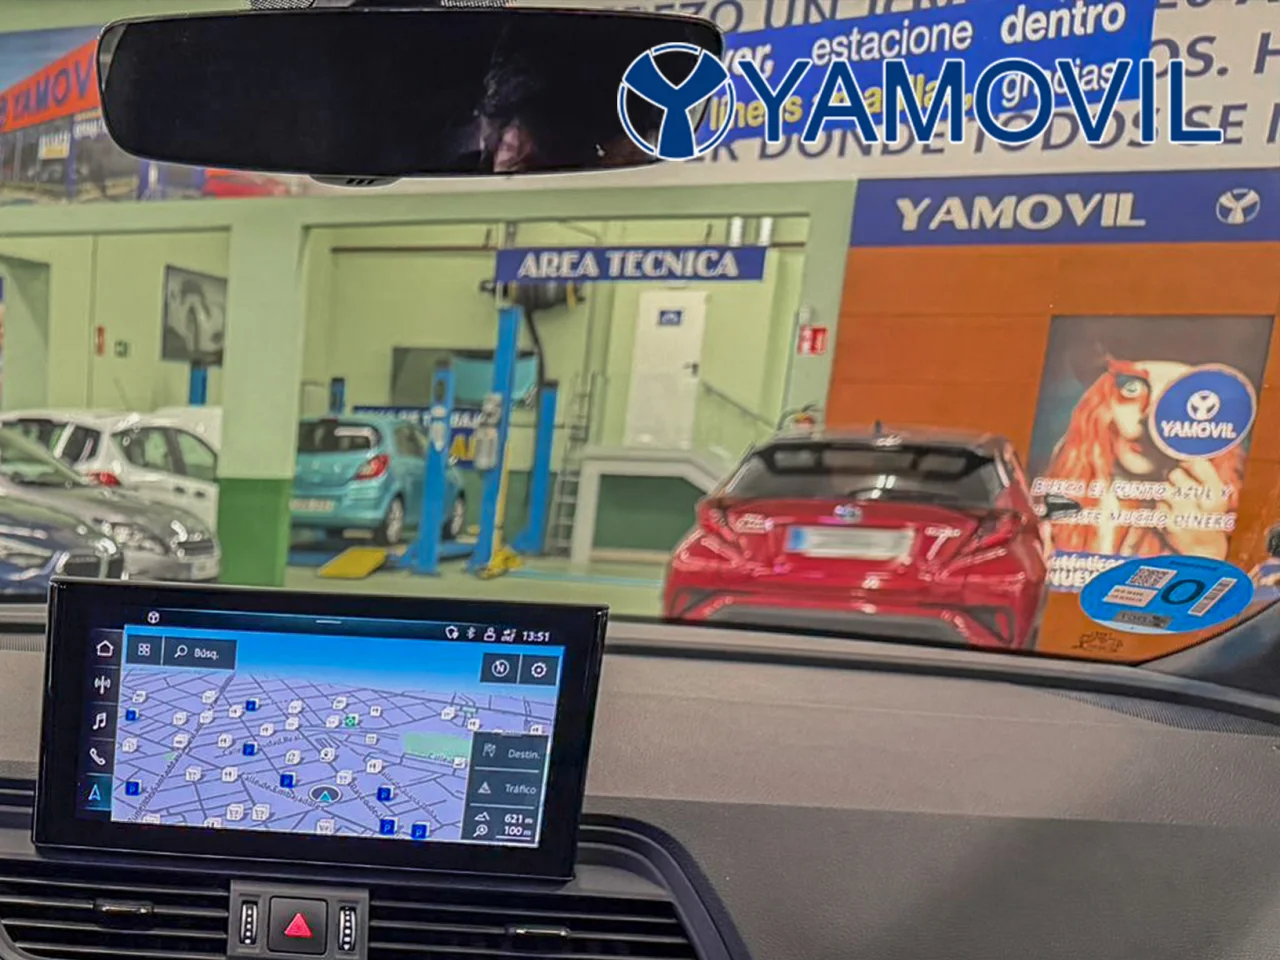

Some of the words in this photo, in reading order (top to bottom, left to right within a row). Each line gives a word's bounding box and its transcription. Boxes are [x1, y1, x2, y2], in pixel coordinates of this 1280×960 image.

[812, 19, 973, 65] estacione
[1001, 3, 1126, 45] dentro
[896, 193, 1145, 231] YAMOVIL
[518, 251, 601, 278] AREA
[606, 251, 739, 278] TECNICA
[1161, 420, 1237, 439] YAMOVIL
[522, 631, 551, 642] 13:51
[194, 648, 219, 660] Búsq.
[508, 748, 540, 760] Destin.
[505, 783, 537, 795] Tráfico
[504, 813, 524, 824] 621
[504, 825, 523, 836] 100
